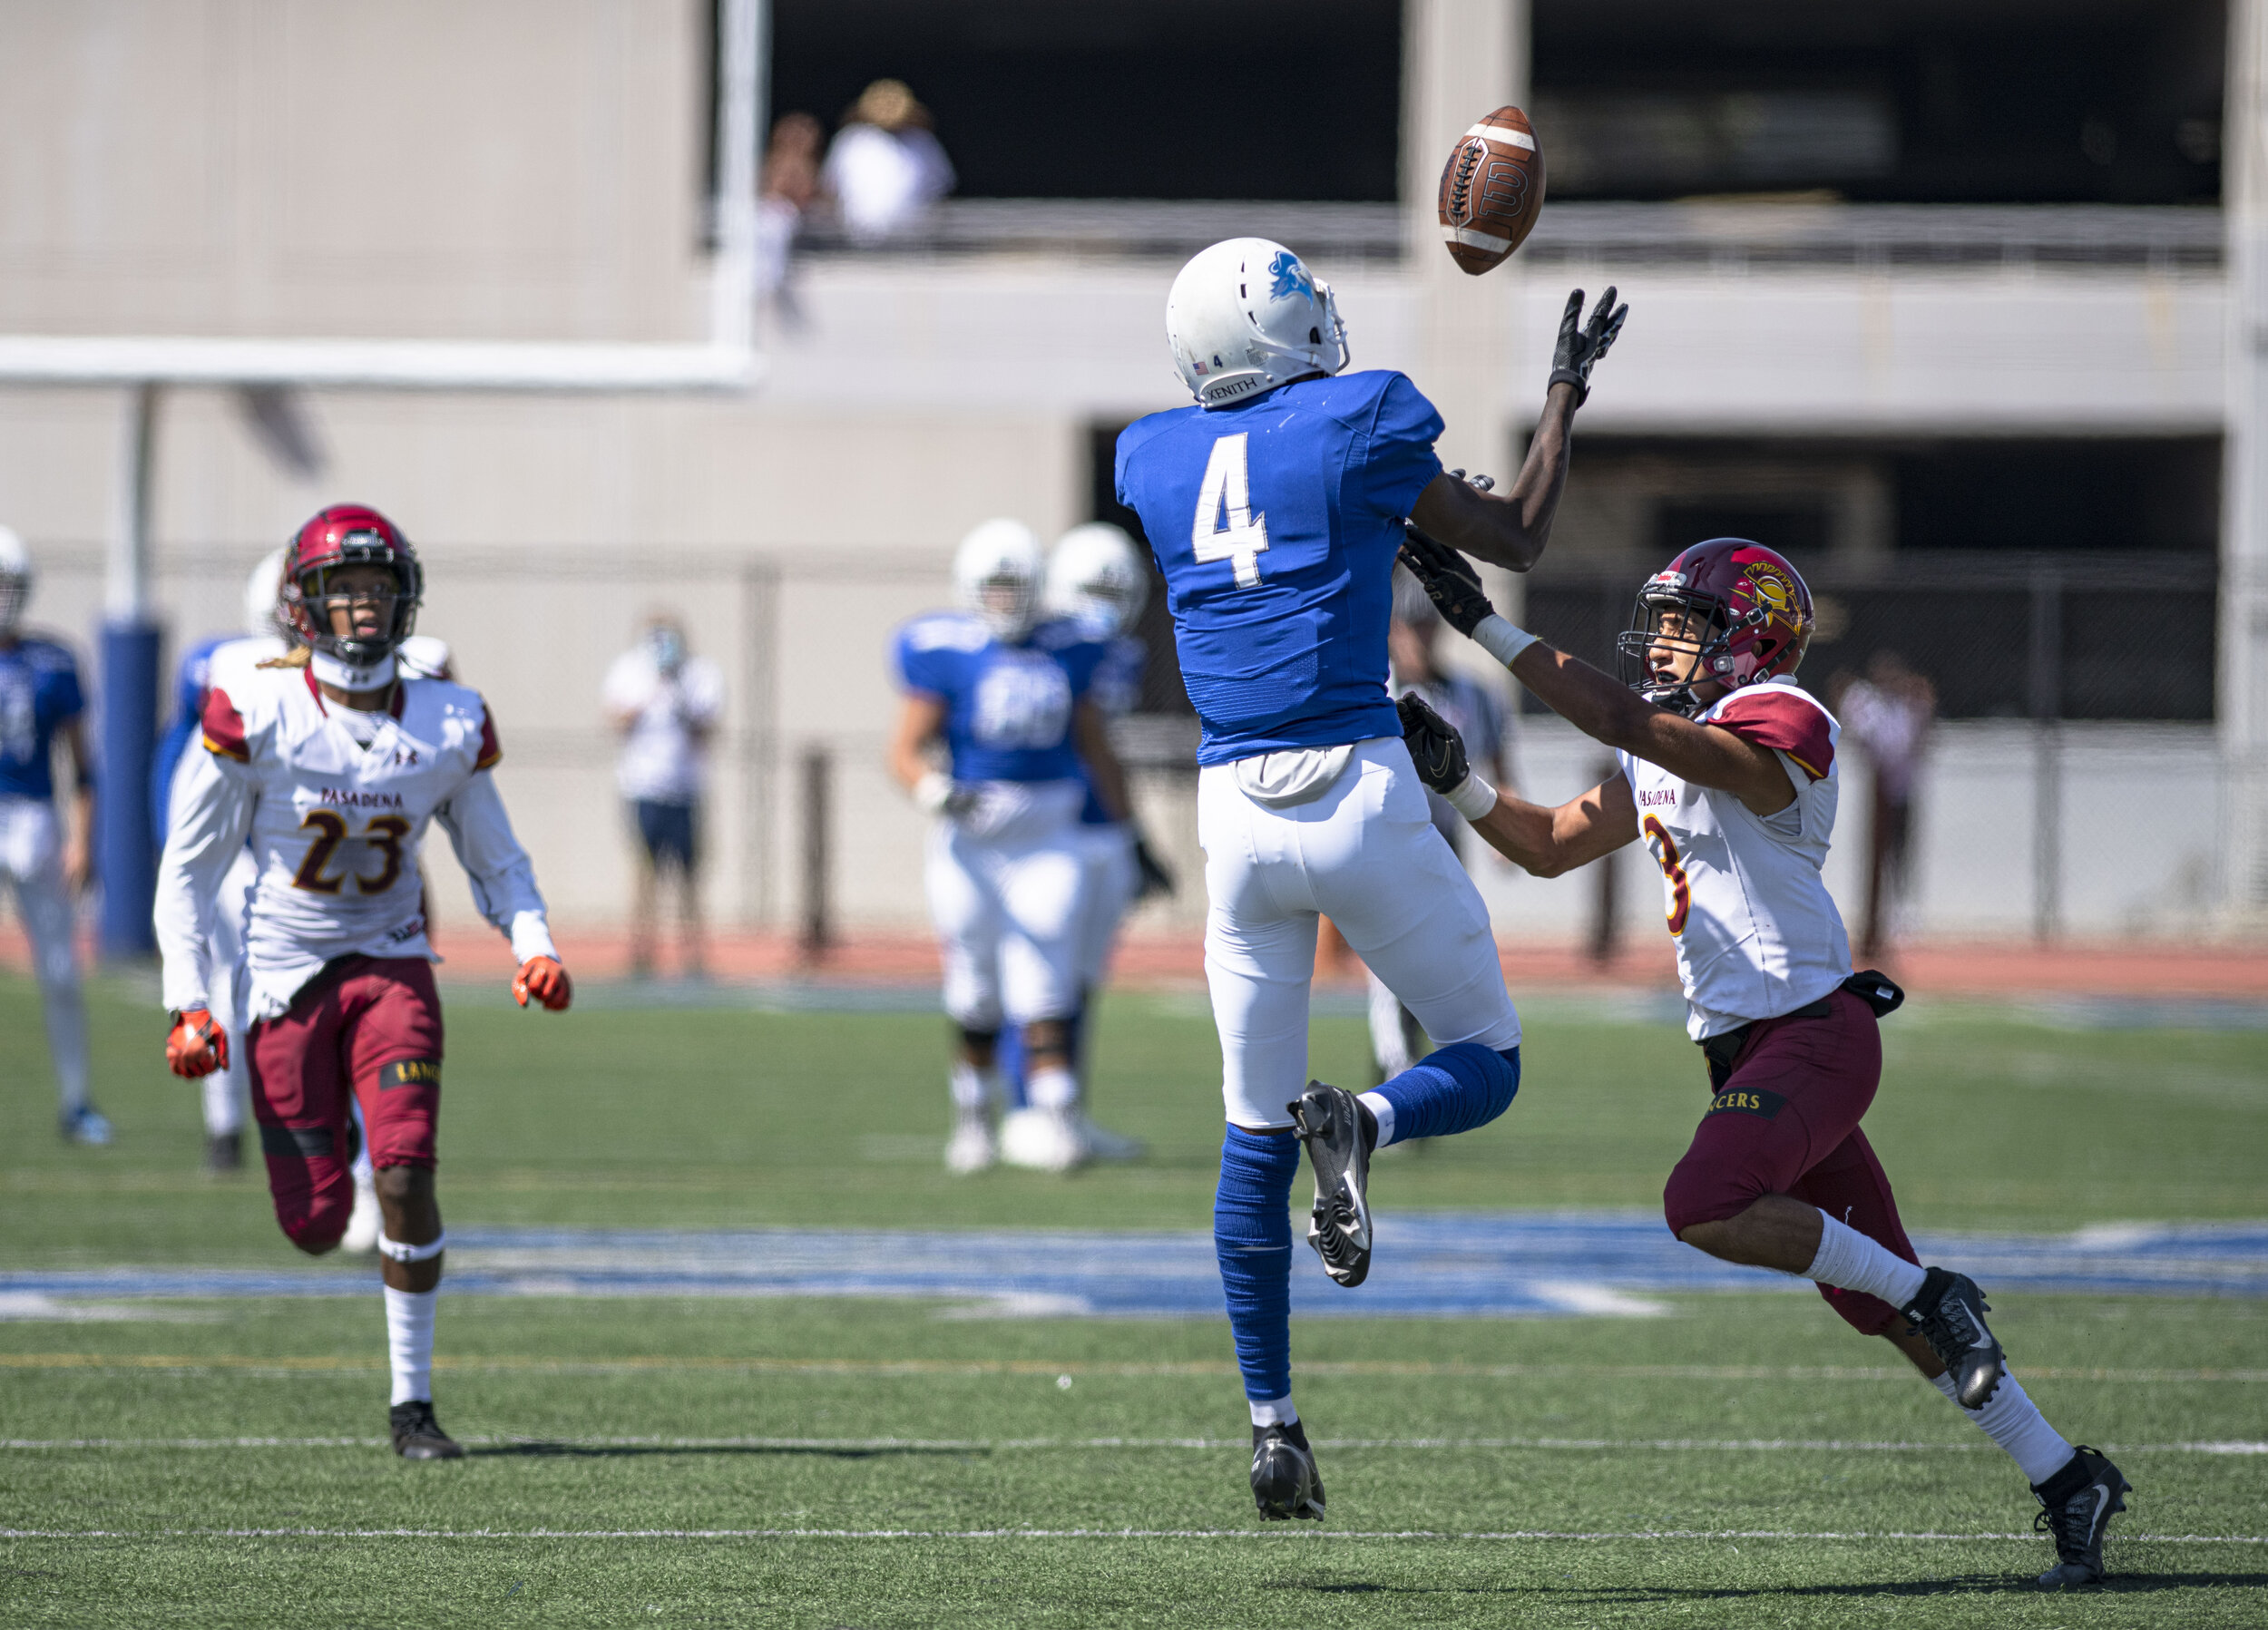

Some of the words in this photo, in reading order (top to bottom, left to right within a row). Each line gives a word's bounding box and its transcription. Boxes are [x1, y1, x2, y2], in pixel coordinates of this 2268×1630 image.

[1207, 376, 1257, 400] XENITH
[1214, 355, 1223, 368] 4
[1192, 432, 1270, 591] 4
[321, 787, 403, 807] PASADENA
[291, 807, 412, 895] 23
[1643, 813, 1691, 937] 3
